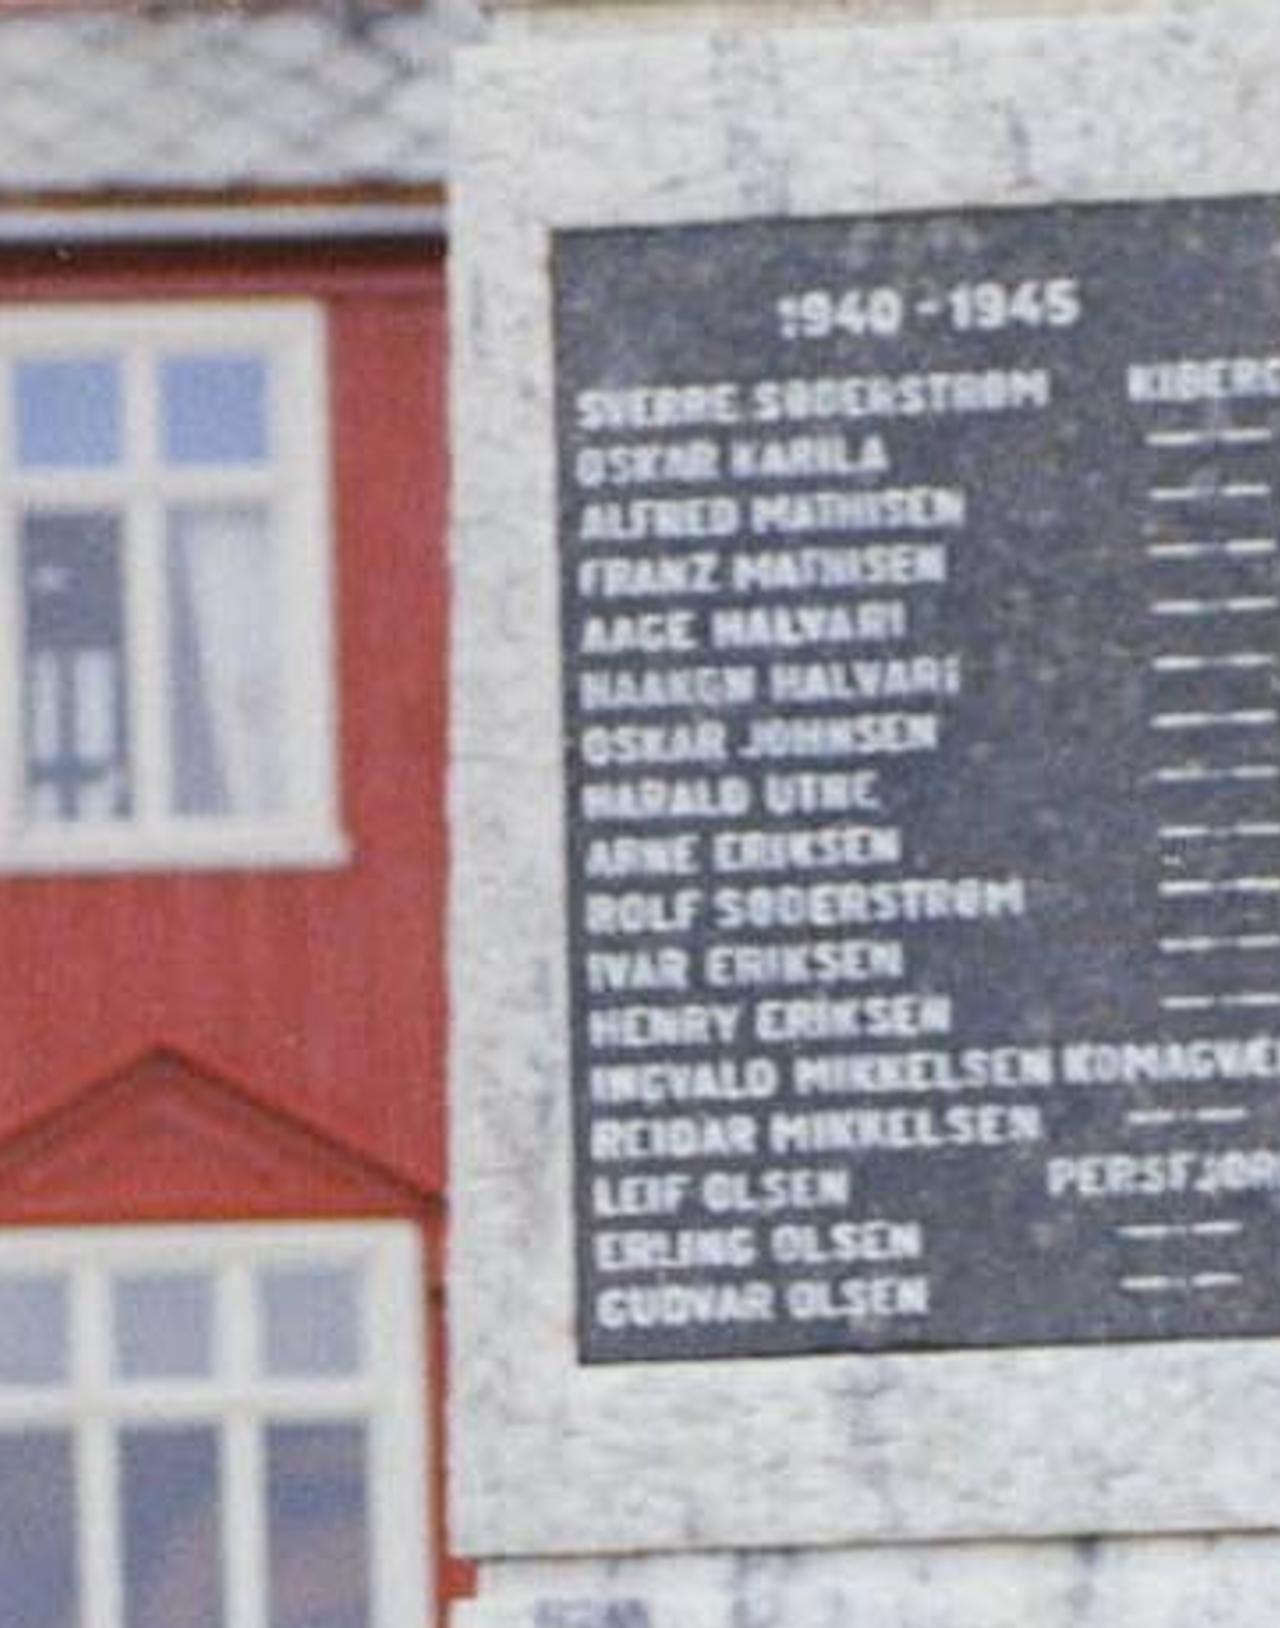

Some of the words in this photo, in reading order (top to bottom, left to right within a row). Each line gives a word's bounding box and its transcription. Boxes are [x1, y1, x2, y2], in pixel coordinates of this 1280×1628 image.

[777, 290, 902, 338] 1940
[948, 279, 1080, 330] 1945
[576, 385, 740, 430] SVERRE
[576, 443, 718, 486] OSKAR
[580, 498, 739, 540] ALFRED
[752, 488, 964, 532] MATHISEN
[580, 554, 718, 596] FRANZ
[732, 545, 946, 590] MATHISEN
[582, 611, 696, 653] AAGE
[716, 603, 904, 646] HALVARI
[581, 667, 754, 710] HAAKON
[772, 658, 960, 701] HALVARI
[582, 722, 726, 765] OSKAR
[740, 714, 936, 758] JOHNSEN
[582, 778, 750, 820] HARALD
[586, 836, 698, 877] ARNE
[716, 828, 900, 872] ERIKSEN
[586, 890, 700, 934] ROLF
[588, 948, 688, 990] IVAR
[706, 940, 902, 986] ERIKSEN
[589, 1004, 738, 1046] HENRY
[756, 996, 950, 1040] ERIKSEN
[794, 1048, 1052, 1094] MIKKELSEN
[590, 1116, 756, 1160] REIDAR
[770, 1106, 1042, 1152] MIKKELSEN
[592, 1174, 688, 1216] LEIF
[702, 1170, 848, 1210] OLSEN
[595, 1228, 756, 1272] ERLING
[772, 1220, 920, 1262] OLSEN
[788, 1277, 929, 1320] OLSEN
